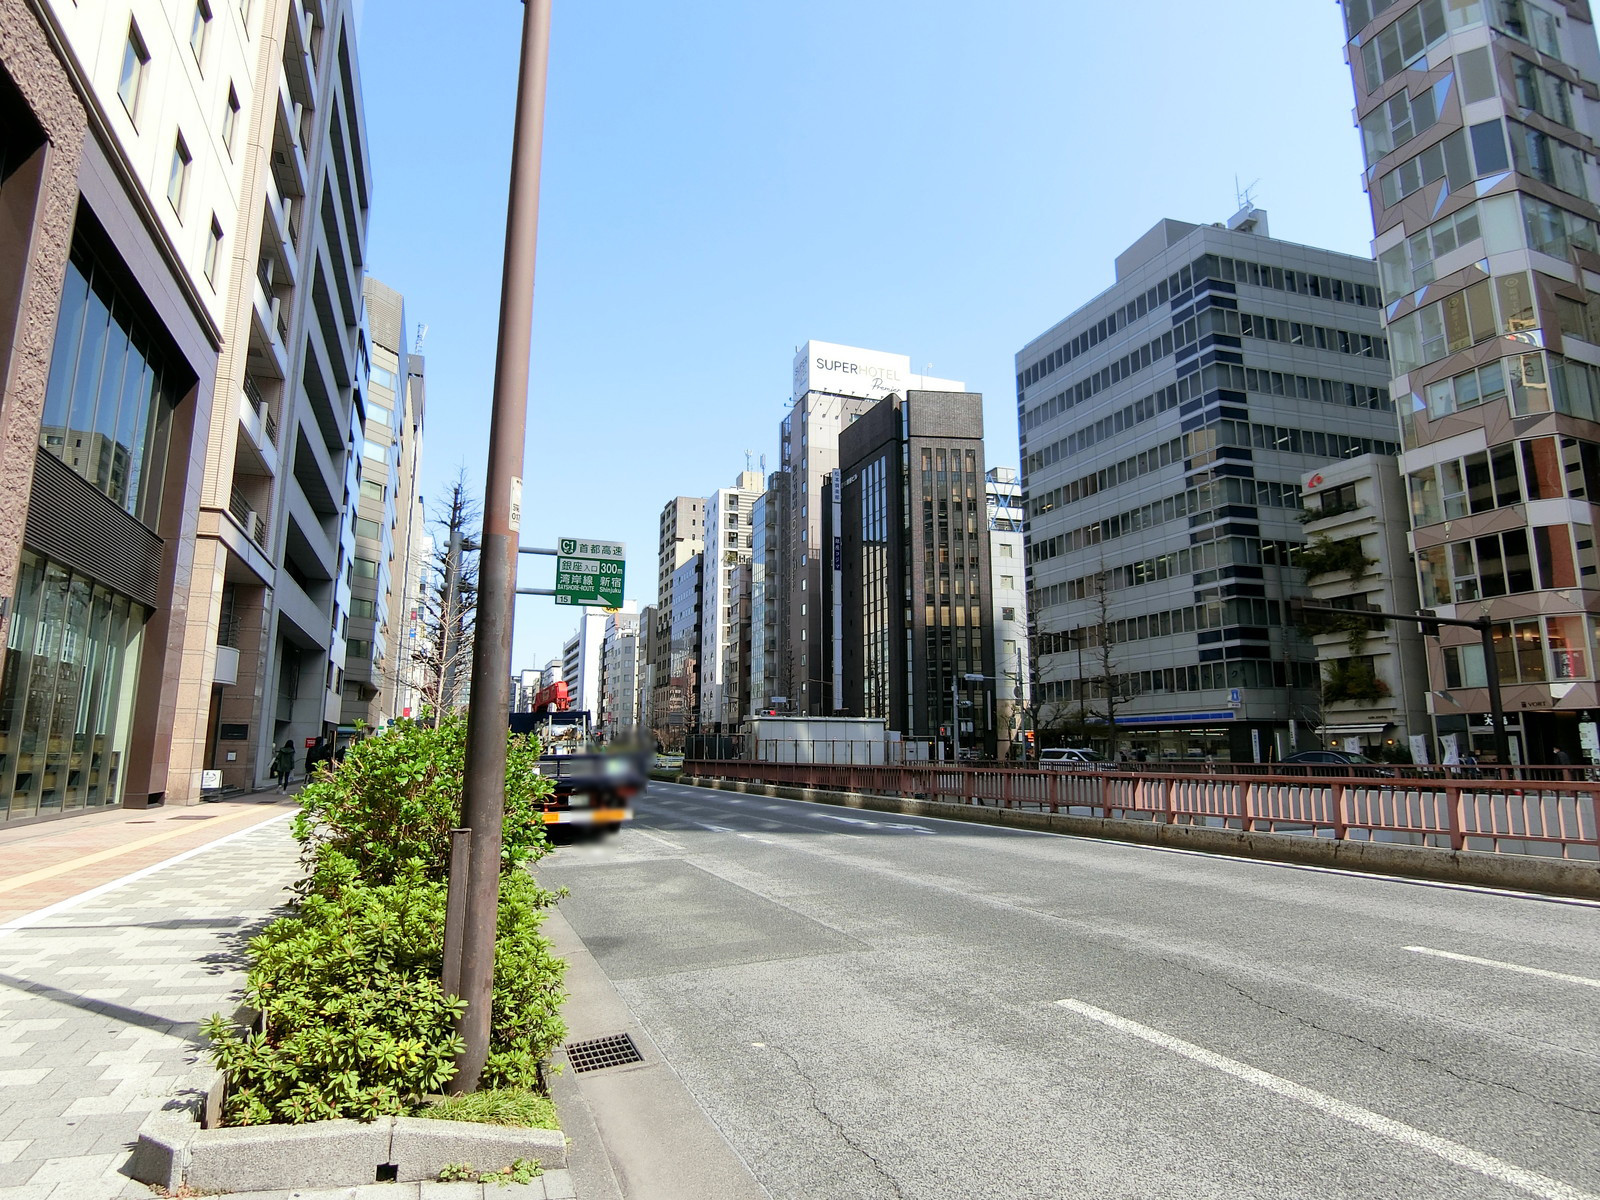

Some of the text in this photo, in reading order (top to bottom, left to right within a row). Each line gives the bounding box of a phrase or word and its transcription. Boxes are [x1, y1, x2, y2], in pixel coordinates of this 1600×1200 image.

[816, 358, 858, 375] SUPER
[858, 364, 901, 382] HOTEL
[872, 377, 902, 393] Premier
[562, 540, 574, 550] C1
[579, 543, 623, 556] 首都高速
[600, 563, 623, 575] 300m
[560, 574, 622, 587] 湾岸線 新宿
